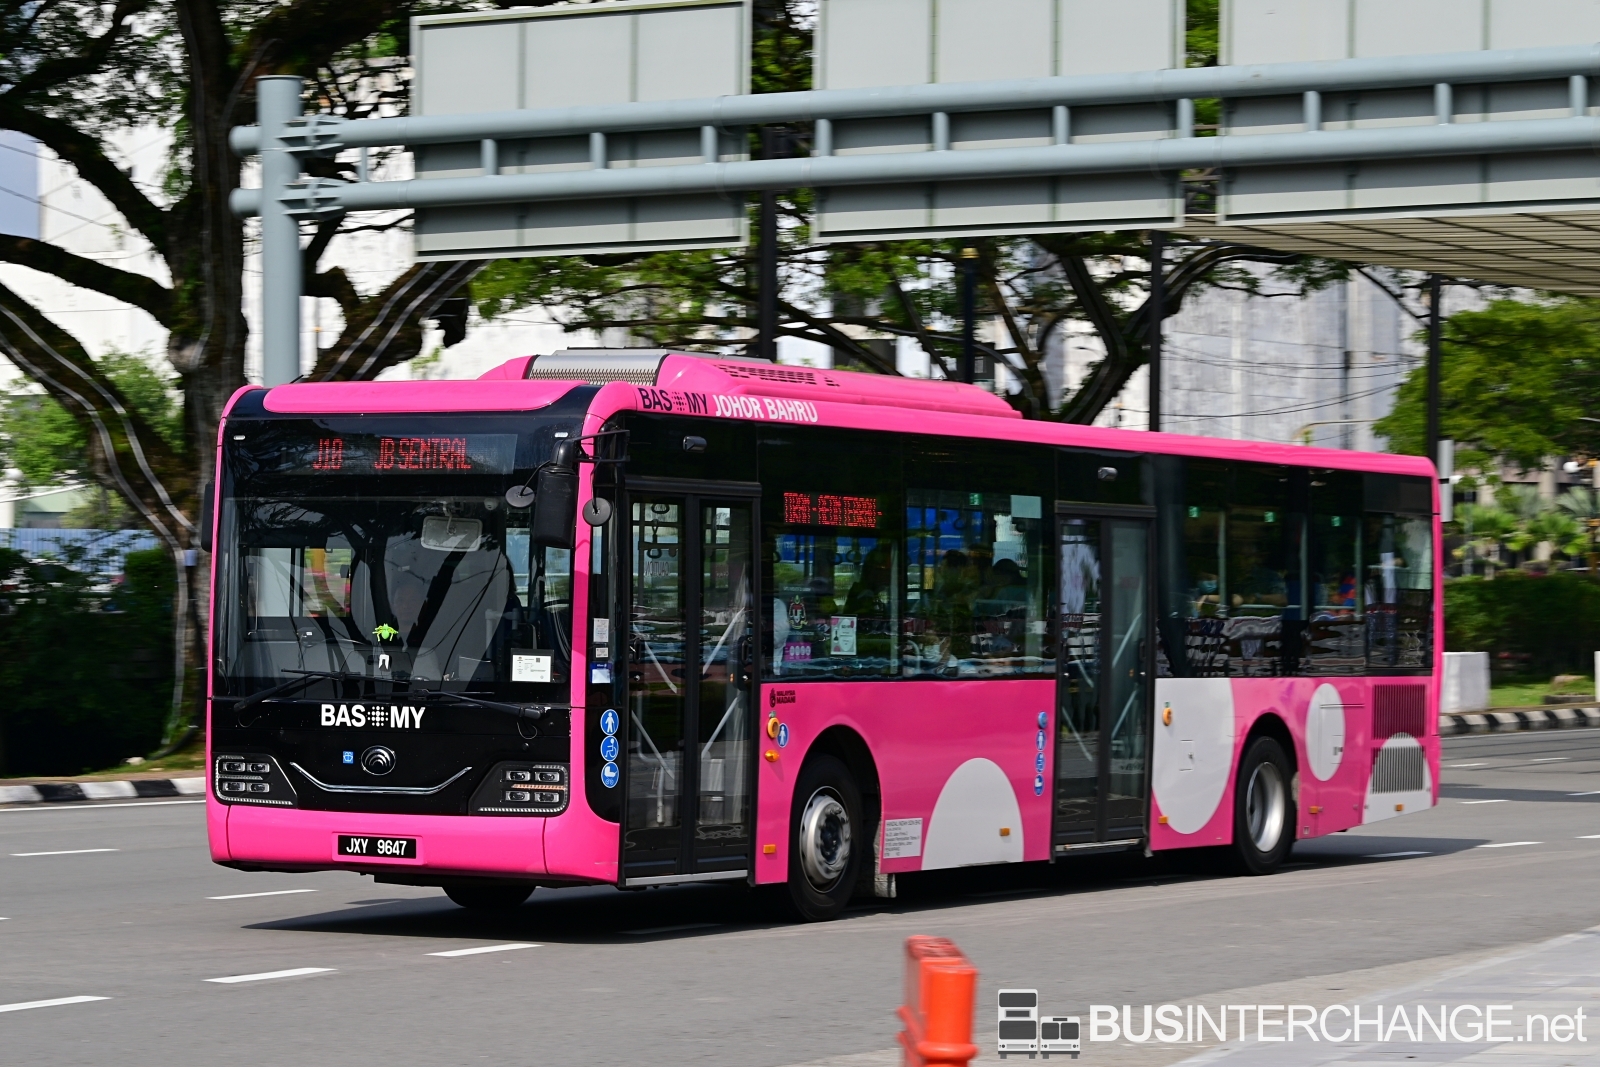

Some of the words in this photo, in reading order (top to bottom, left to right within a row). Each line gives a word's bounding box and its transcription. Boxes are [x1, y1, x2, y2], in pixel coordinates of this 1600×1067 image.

[637, 387, 673, 412] BAS
[683, 391, 709, 415] MY
[712, 394, 765, 419] JOHOR
[763, 398, 819, 423] BAHRU
[374, 437, 395, 470] JB
[397, 437, 472, 470] SENTRAL
[320, 703, 367, 728] BAS
[390, 705, 426, 729] MY
[346, 837, 369, 854] JXY
[377, 839, 407, 856] 9647
